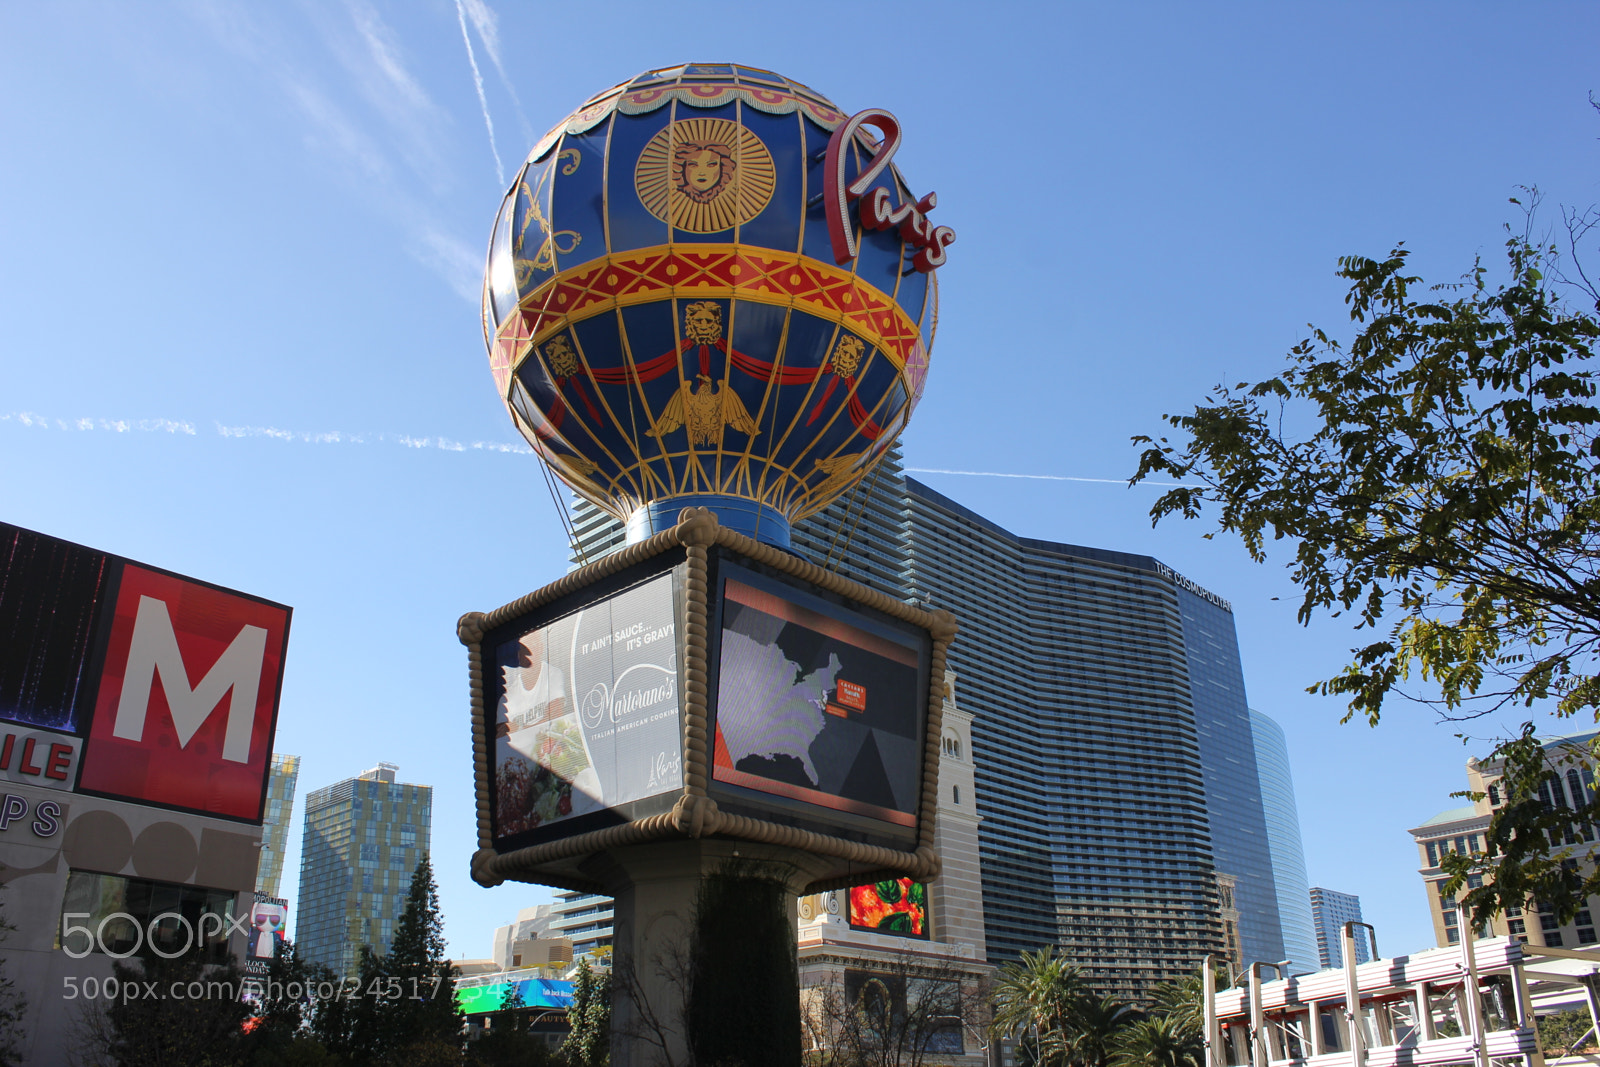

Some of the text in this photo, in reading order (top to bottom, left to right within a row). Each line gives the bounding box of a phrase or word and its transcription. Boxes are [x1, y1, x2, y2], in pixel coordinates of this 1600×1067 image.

[823, 108, 956, 274] Paris
[1154, 560, 1232, 612] THE COSMOPOLITAN
[582, 622, 652, 655] IT AIN'T SAUCE...
[626, 623, 675, 652] IT'S GRAVY
[113, 594, 268, 764] M
[581, 664, 676, 729] Martorano's
[591, 728, 615, 741] ITALIAN
[617, 718, 648, 733] AMERICAN
[244, 960, 270, 969] LOCK
